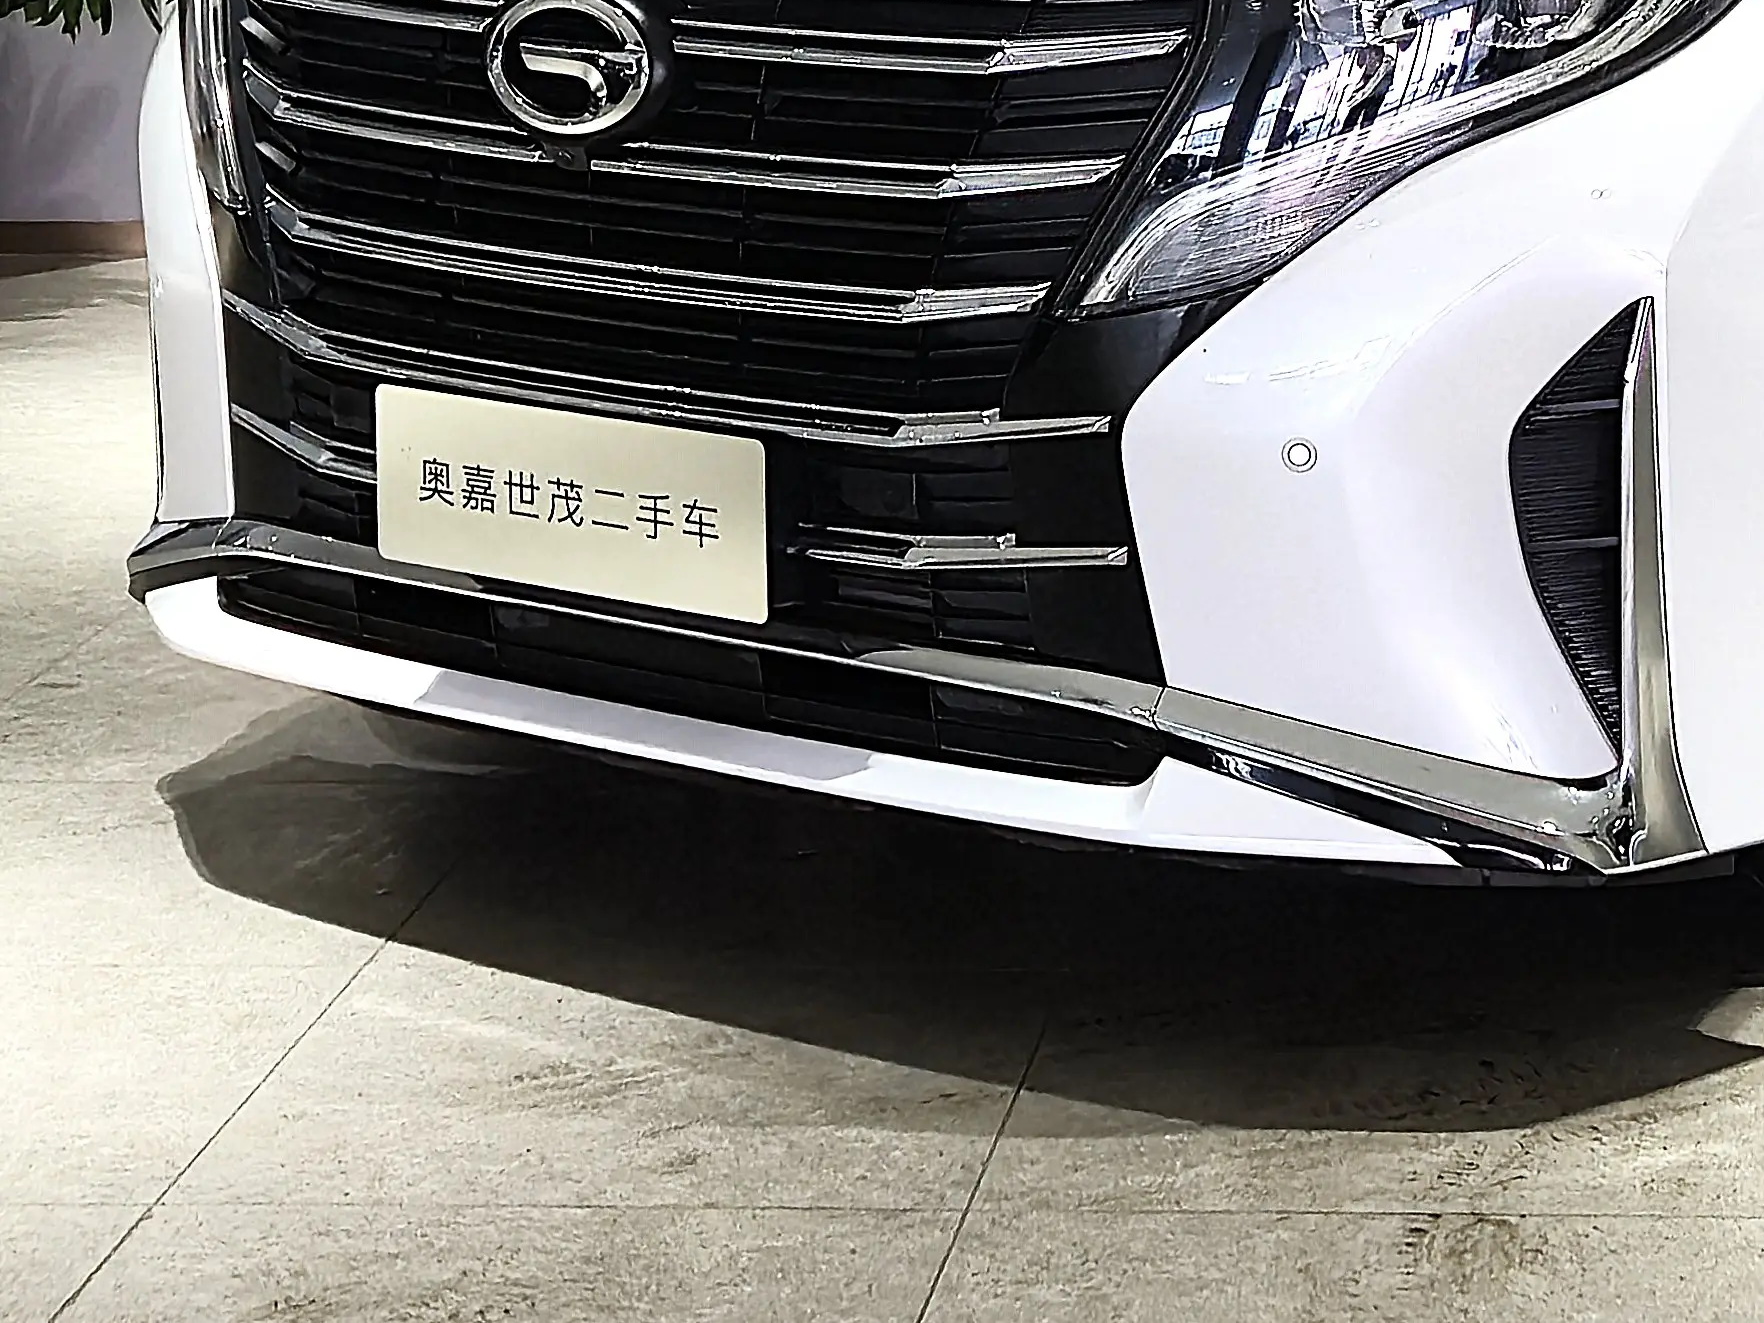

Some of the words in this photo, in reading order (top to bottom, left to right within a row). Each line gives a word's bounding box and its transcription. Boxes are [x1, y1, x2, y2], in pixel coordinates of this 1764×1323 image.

[418, 457, 721, 549] 奥嘉世茂二手车
